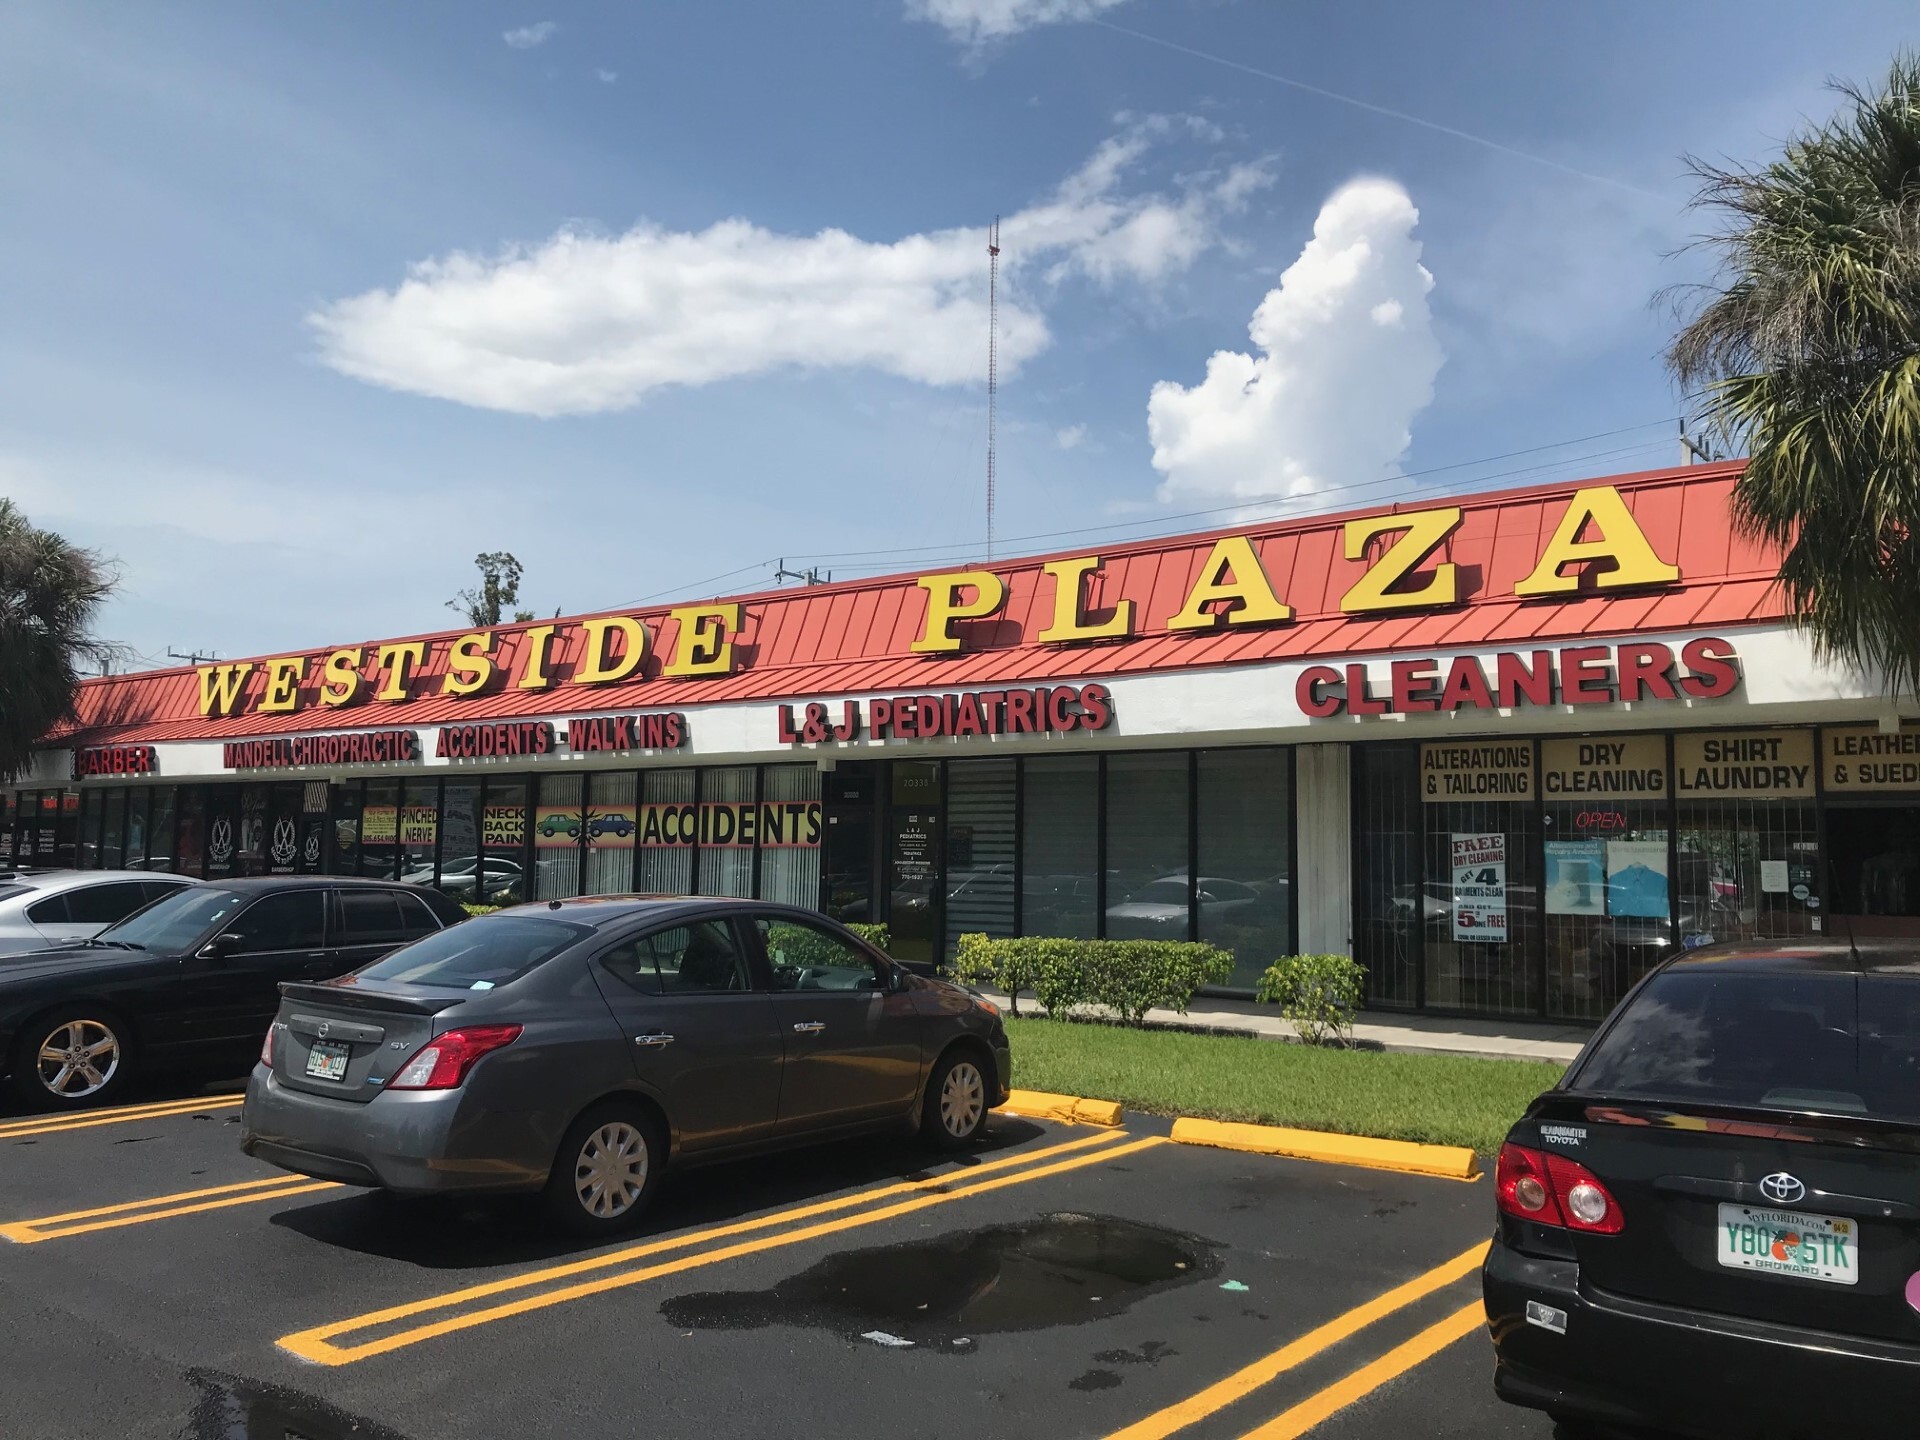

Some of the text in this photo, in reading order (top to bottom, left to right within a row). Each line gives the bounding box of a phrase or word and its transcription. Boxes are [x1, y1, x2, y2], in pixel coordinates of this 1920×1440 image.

[197, 486, 1681, 716] WESTSIDE PLAZA
[1295, 636, 1738, 718] CLEANERS
[869, 683, 1111, 740] PEDIATRICS
[435, 712, 681, 758] ACCIDENTS WALK INS
[223, 730, 414, 769] MANDELL CHIROPRACTIC
[1424, 746, 1531, 770] ALTERATIONS
[1578, 743, 1626, 766] DRY
[1703, 737, 1783, 763] SHIRT
[78, 745, 151, 775] BARBER
[1426, 772, 1529, 795] & TAILORING
[1545, 768, 1664, 793] CLEANING
[1679, 764, 1810, 790] LAUNDRY
[1834, 763, 1920, 784] & SUED
[401, 807, 437, 824] PINCHED
[484, 808, 526, 819] NECK
[1576, 812, 1627, 828] OPEN
[484, 821, 525, 832] BACK
[642, 803, 821, 845] ACCIDENTS
[406, 827, 432, 842] NERVE
[485, 834, 524, 844] PAIN
[1452, 836, 1504, 854] FREE
[1454, 850, 1504, 867] DRY CLEANING
[1460, 868, 1500, 886] GET 4
[1454, 886, 1504, 897] GARMENTS CLEAN
[1487, 914, 1506, 928] FREE
[390, 1042, 410, 1050] SV
[1544, 1135, 1580, 1146] TOYOTA
[1747, 1212, 1827, 1232] MYFLORIDA.COM
[1755, 1258, 1820, 1276] BROWARD
